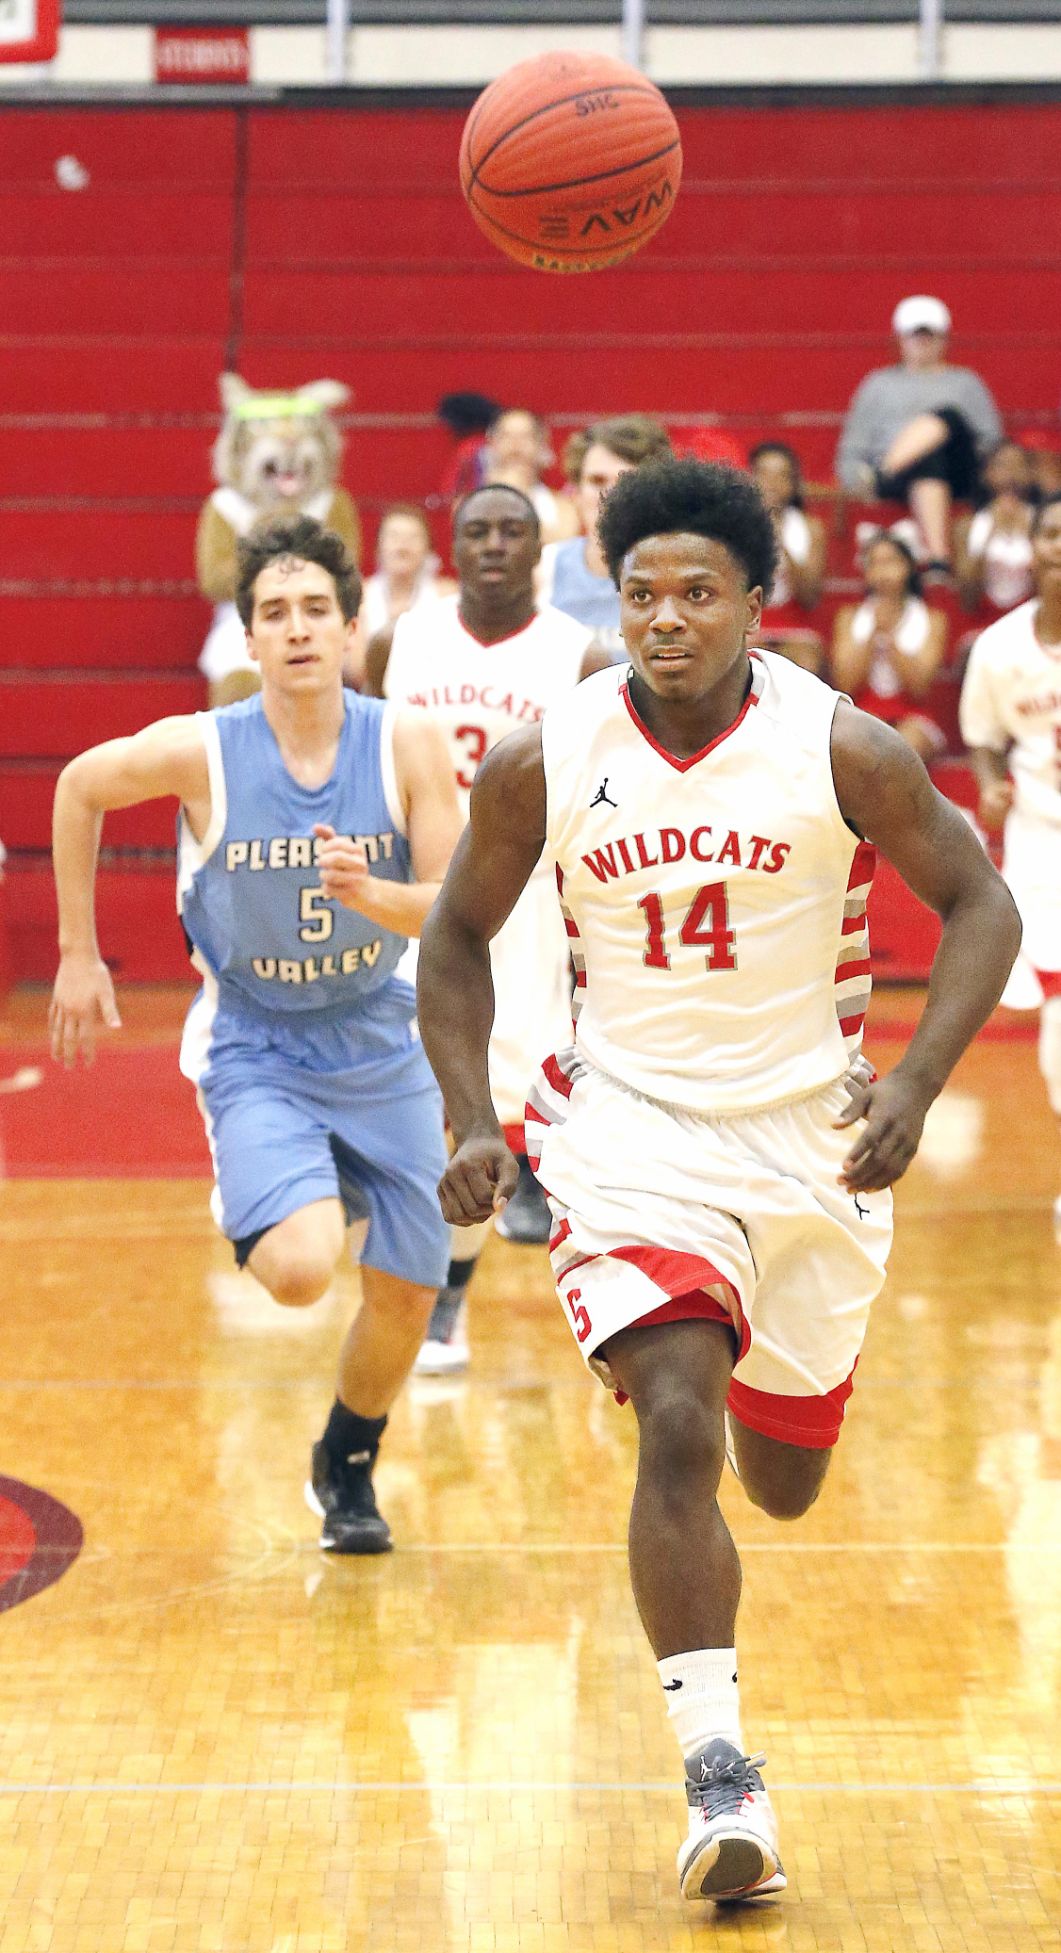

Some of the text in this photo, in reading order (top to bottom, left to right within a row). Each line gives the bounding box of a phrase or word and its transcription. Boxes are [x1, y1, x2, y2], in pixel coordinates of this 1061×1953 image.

[538, 179, 673, 239] WAVE
[407, 684, 543, 723] WILDCATS
[454, 724, 487, 789] 3
[225, 831, 394, 873] PLEANT
[580, 825, 792, 884] WILDCATS
[299, 886, 334, 943] 5
[636, 880, 739, 972] 14
[252, 938, 383, 985] VALLEY
